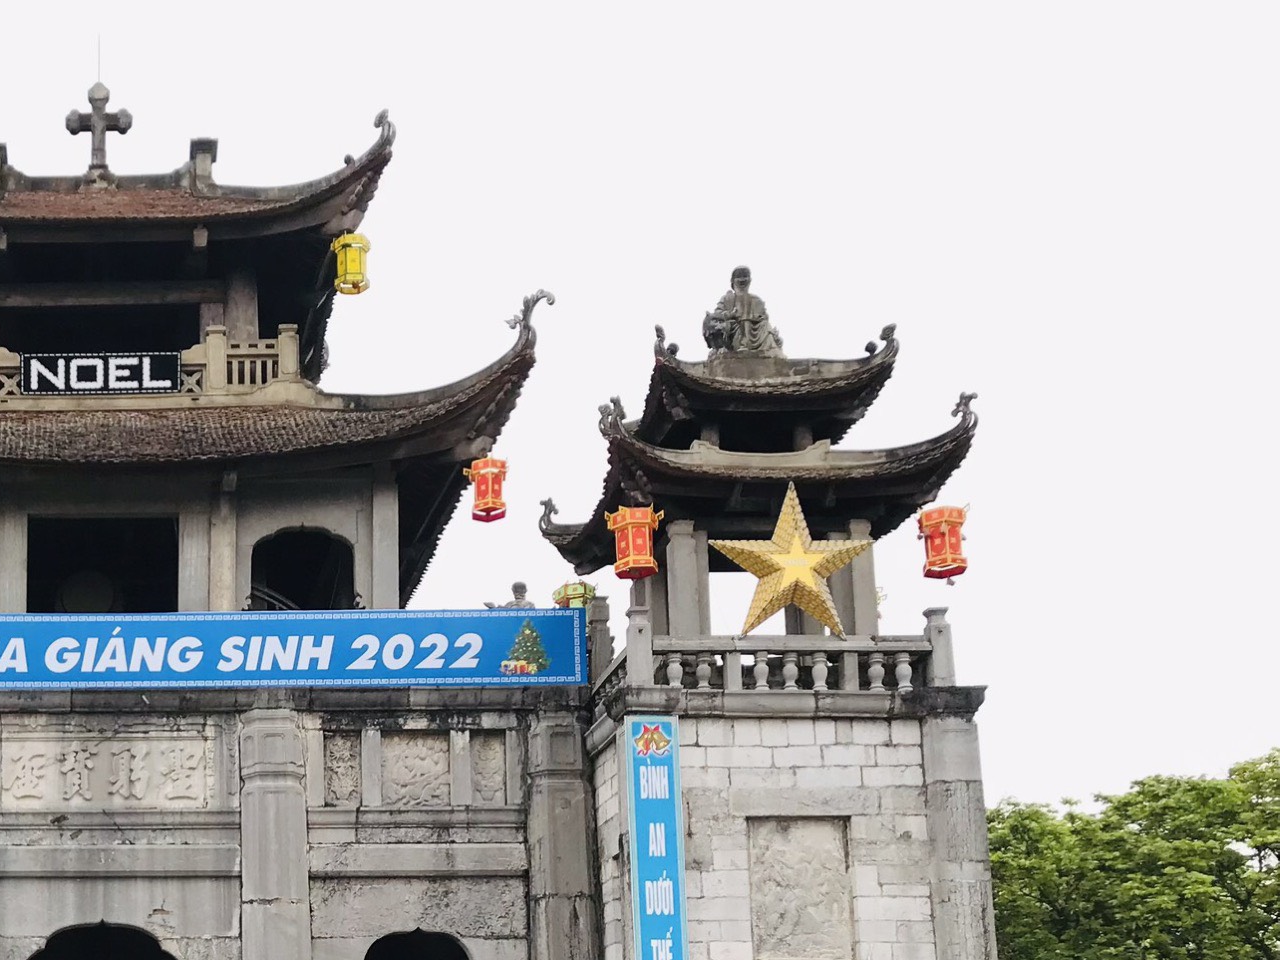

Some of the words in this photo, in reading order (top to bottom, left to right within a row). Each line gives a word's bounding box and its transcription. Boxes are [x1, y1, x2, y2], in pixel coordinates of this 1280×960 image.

[30, 357, 172, 390] NOEL
[45, 626, 204, 674] GIÁNG
[217, 635, 335, 672] SINH
[346, 632, 485, 671] 2022
[639, 759, 669, 799] BÌNH
[649, 823, 666, 857] AN
[645, 870, 674, 915] DƯỚI
